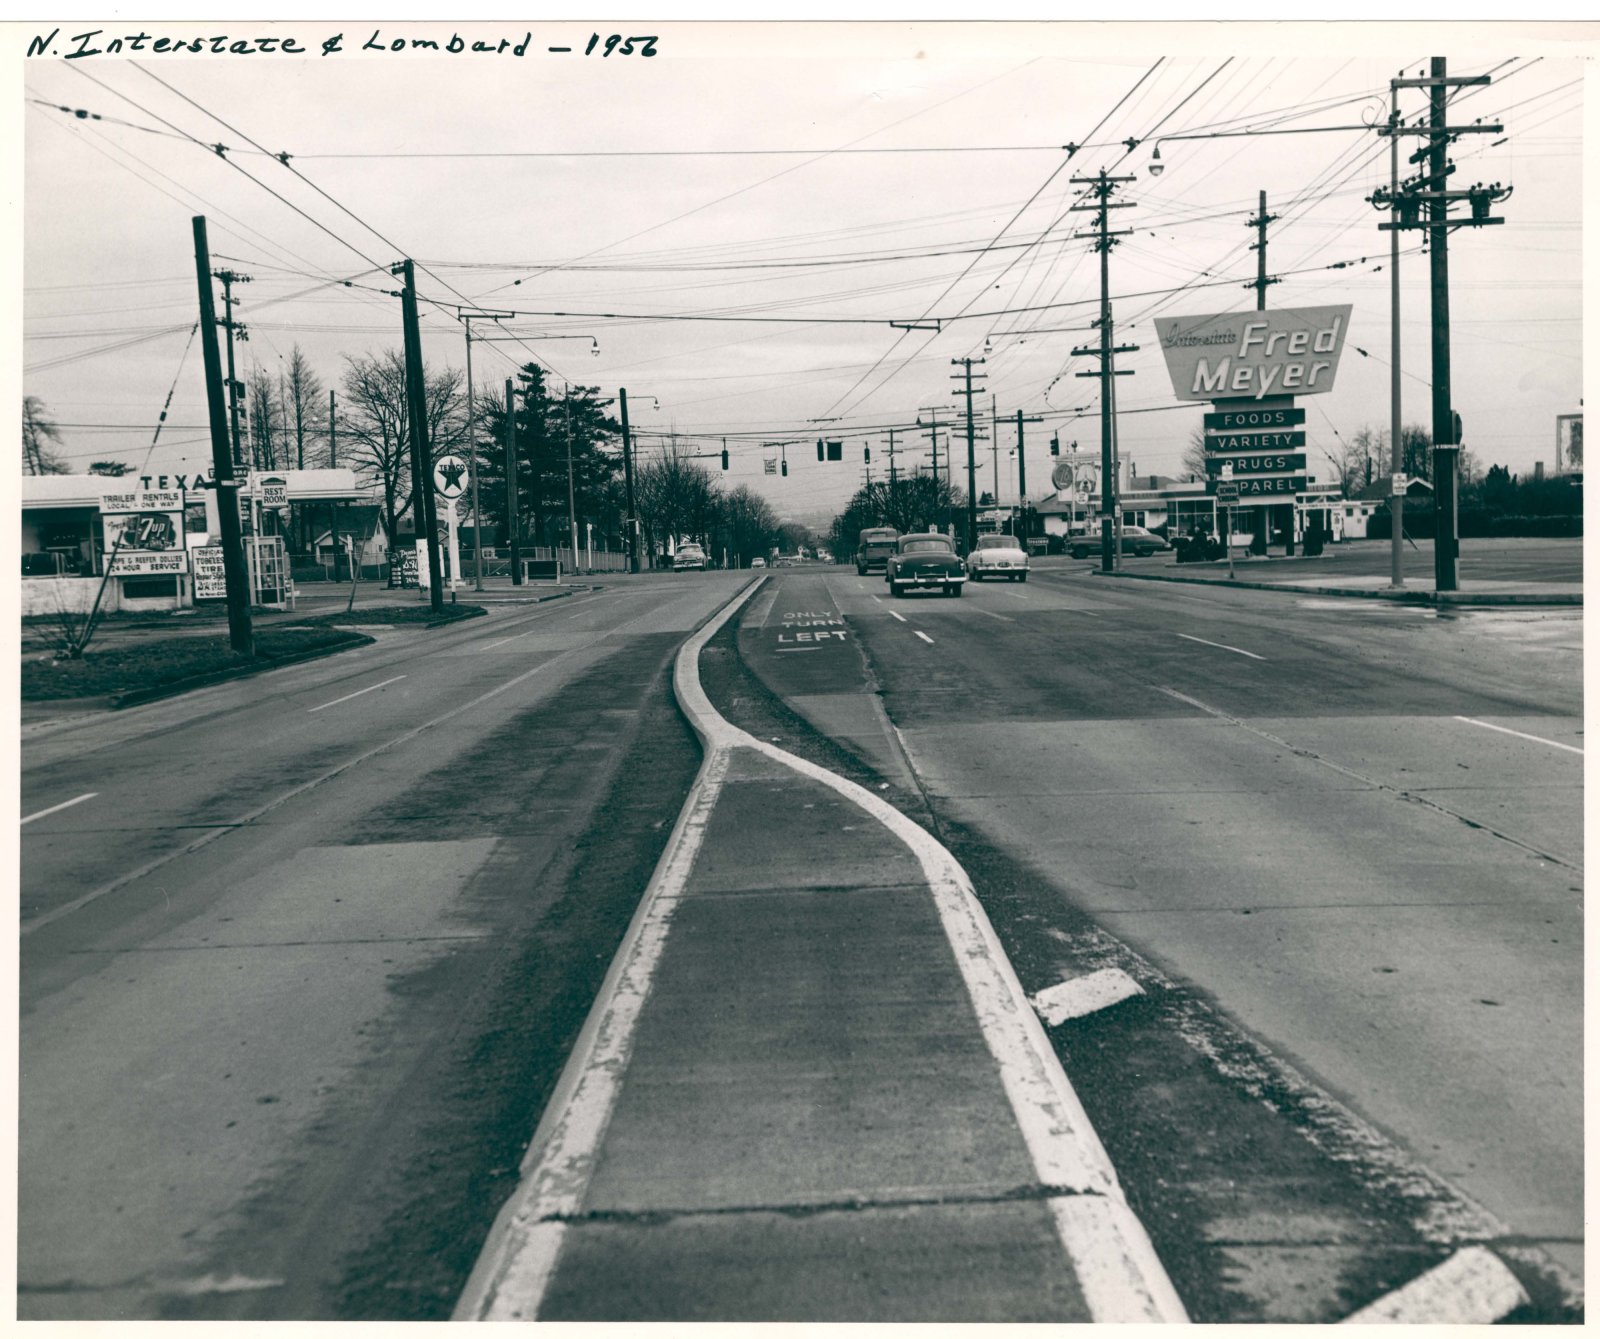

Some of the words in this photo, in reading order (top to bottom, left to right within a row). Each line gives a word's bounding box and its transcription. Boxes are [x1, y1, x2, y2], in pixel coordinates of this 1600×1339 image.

[1238, 315, 1343, 358] Fred
[1191, 356, 1331, 399] Meyer
[1224, 412, 1286, 425] FOODS
[1217, 434, 1293, 448] VARIETY
[140, 475, 207, 491] TEXA
[1239, 480, 1297, 492] PAREL
[264, 487, 284, 495] REST
[103, 494, 136, 502] TRAILER
[142, 493, 178, 501] RENTALS
[196, 557, 224, 565] TUBELES
[783, 611, 832, 619] ONLY
[781, 619, 844, 628] TURN
[778, 630, 847, 643] LEFT
